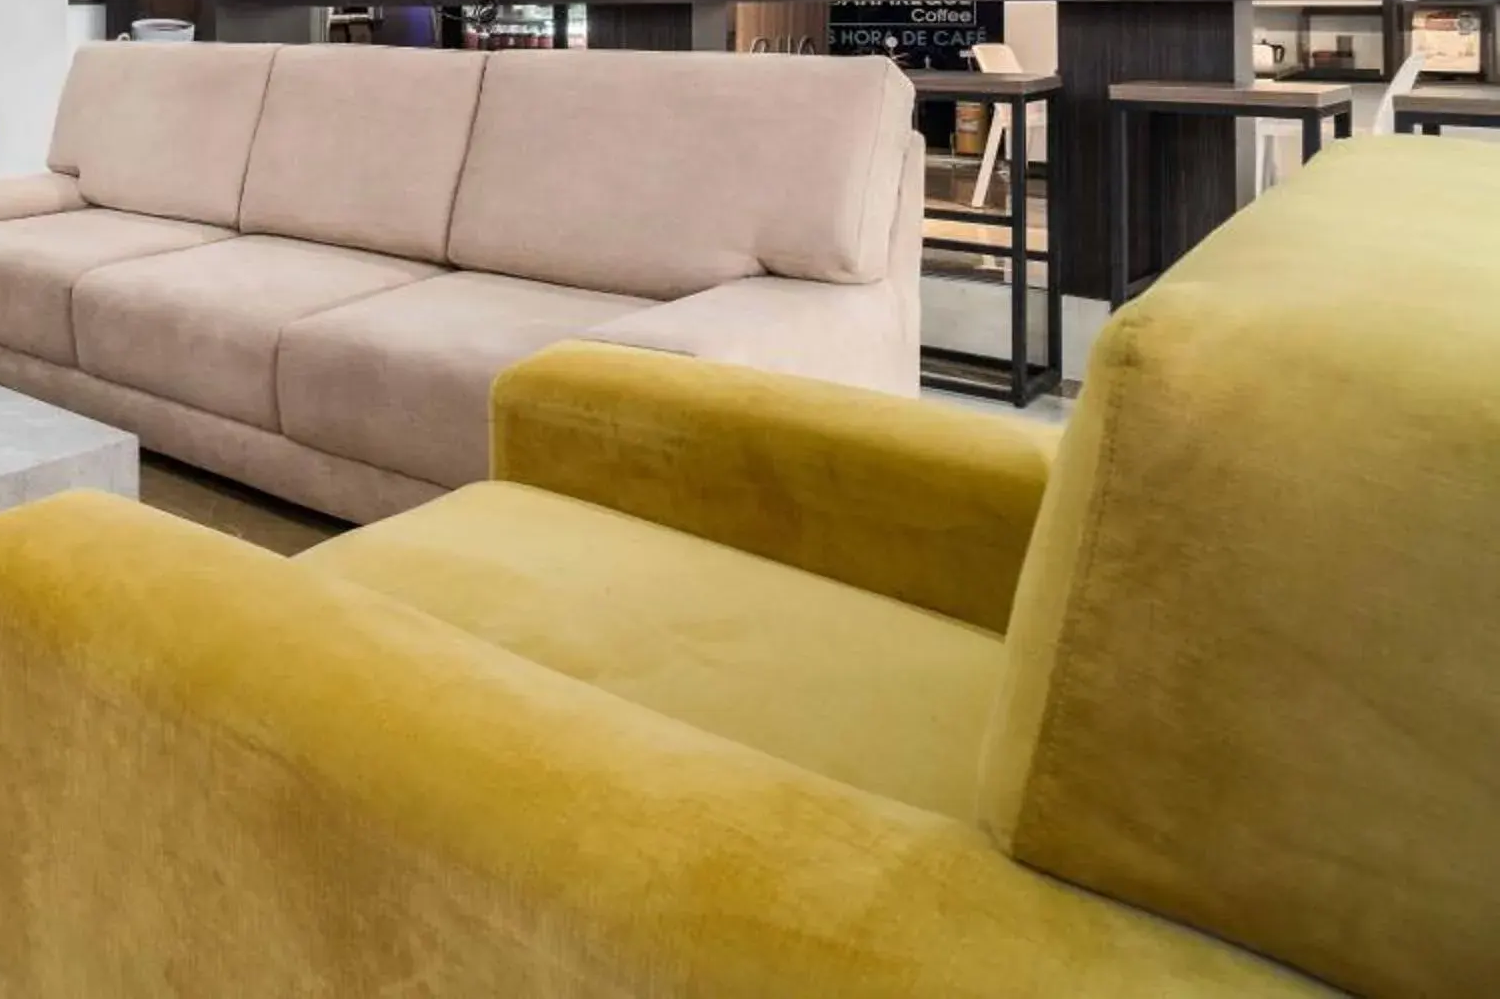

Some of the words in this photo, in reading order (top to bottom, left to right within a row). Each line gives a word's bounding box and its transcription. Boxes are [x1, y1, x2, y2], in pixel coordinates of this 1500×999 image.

[911, 8, 972, 22] Coffee
[903, 30, 927, 46] DE
[933, 26, 988, 46] CAFÉ
